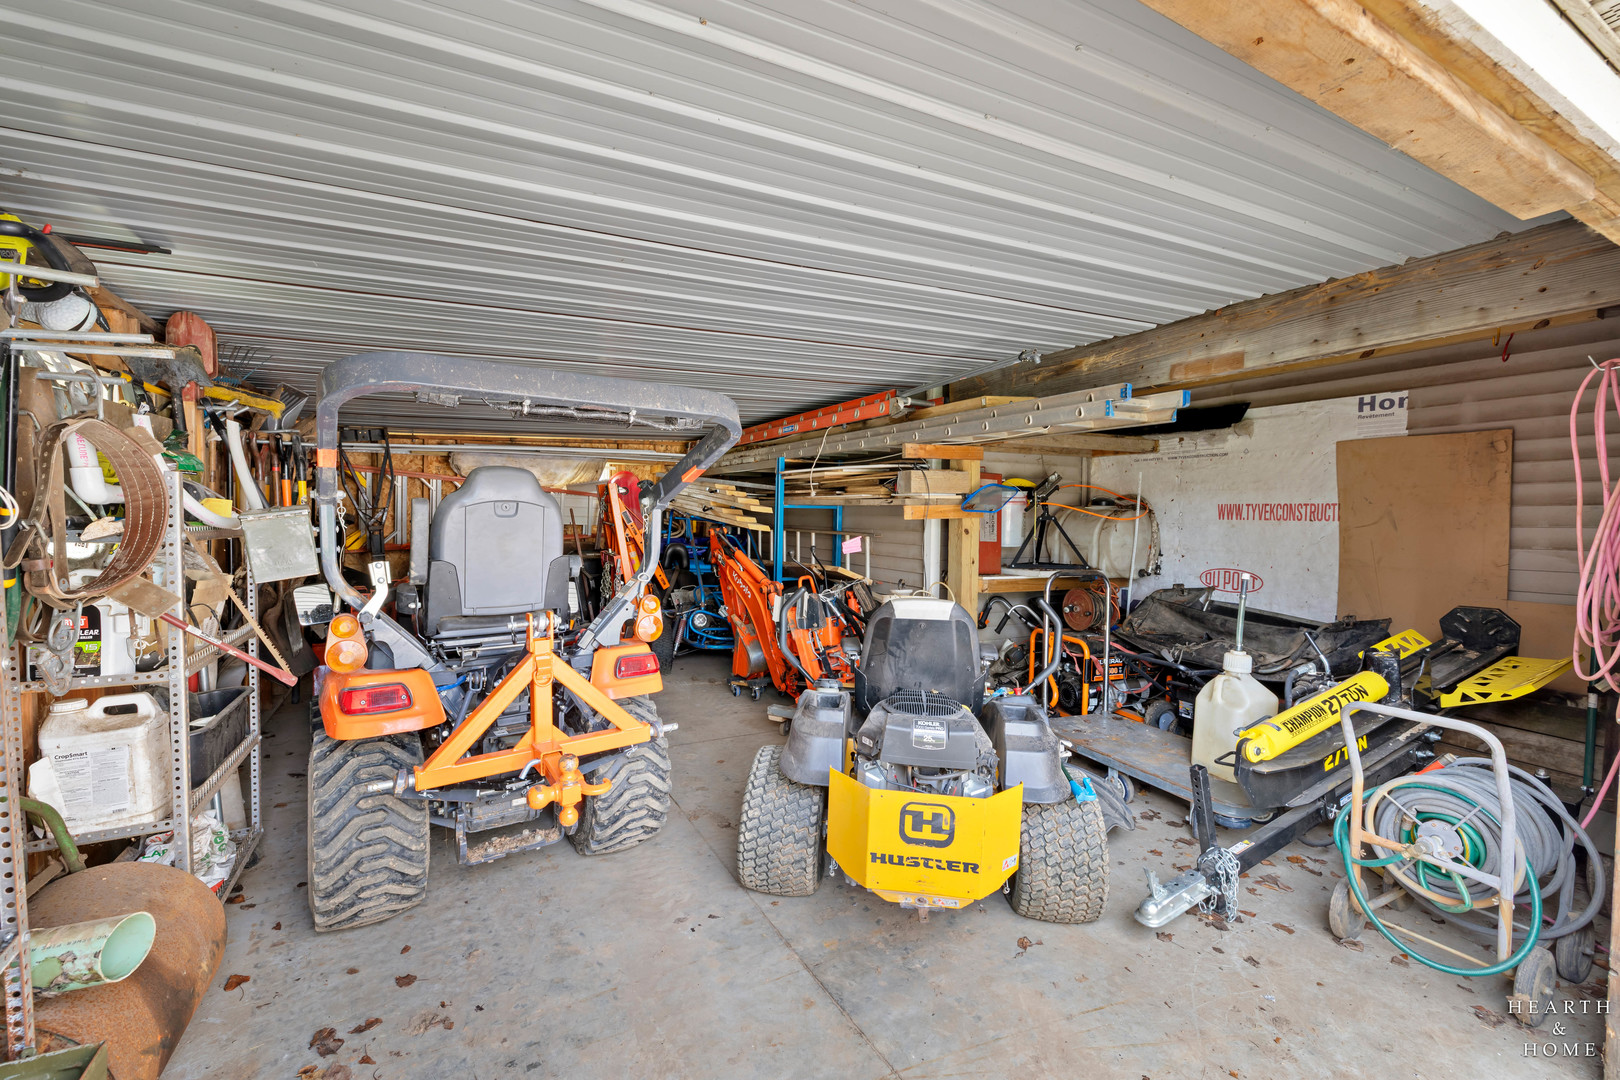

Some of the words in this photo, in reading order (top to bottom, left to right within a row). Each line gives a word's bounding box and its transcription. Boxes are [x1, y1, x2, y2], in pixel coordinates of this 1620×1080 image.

[1223, 570, 1258, 591] POT
[1282, 704, 1327, 733] CHAMPION
[1321, 695, 1343, 715] 27
[54, 752, 88, 760] CropSmart
[1341, 735, 1368, 760] TN
[870, 852, 980, 874] HUSTLER
